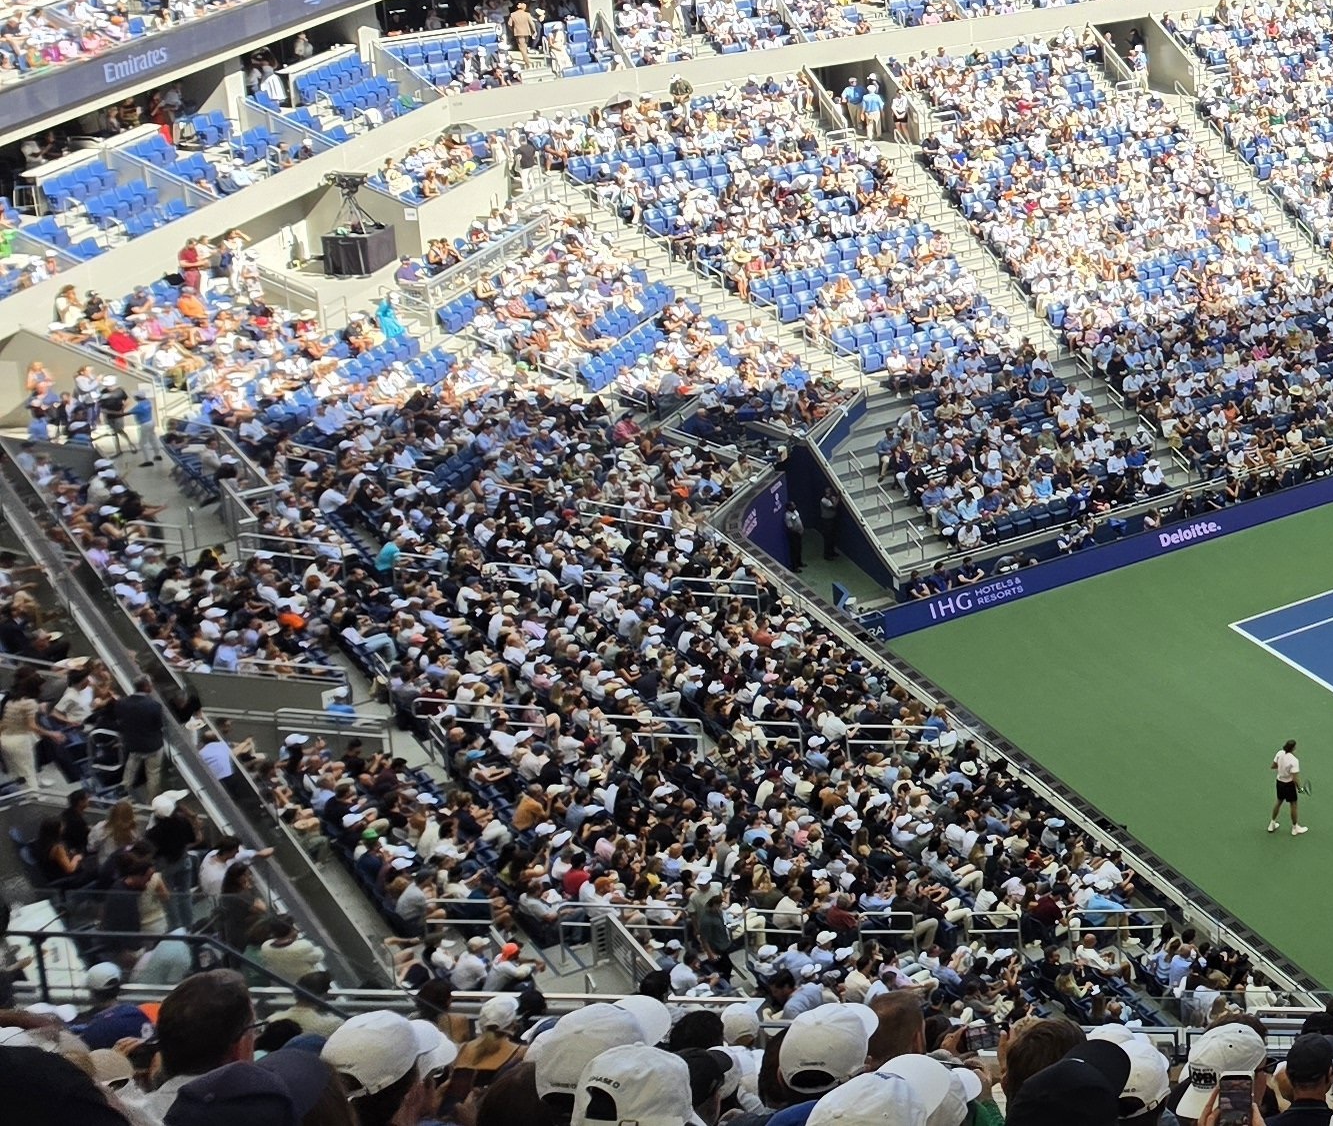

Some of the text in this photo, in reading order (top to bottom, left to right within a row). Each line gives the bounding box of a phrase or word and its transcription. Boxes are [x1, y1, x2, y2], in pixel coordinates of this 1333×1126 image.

[102, 46, 169, 84] Emirates
[1159, 520, 1222, 548] Deloitte.
[929, 576, 1022, 619] IHG HOTELS &
[977, 586, 1024, 605] RESORTS
